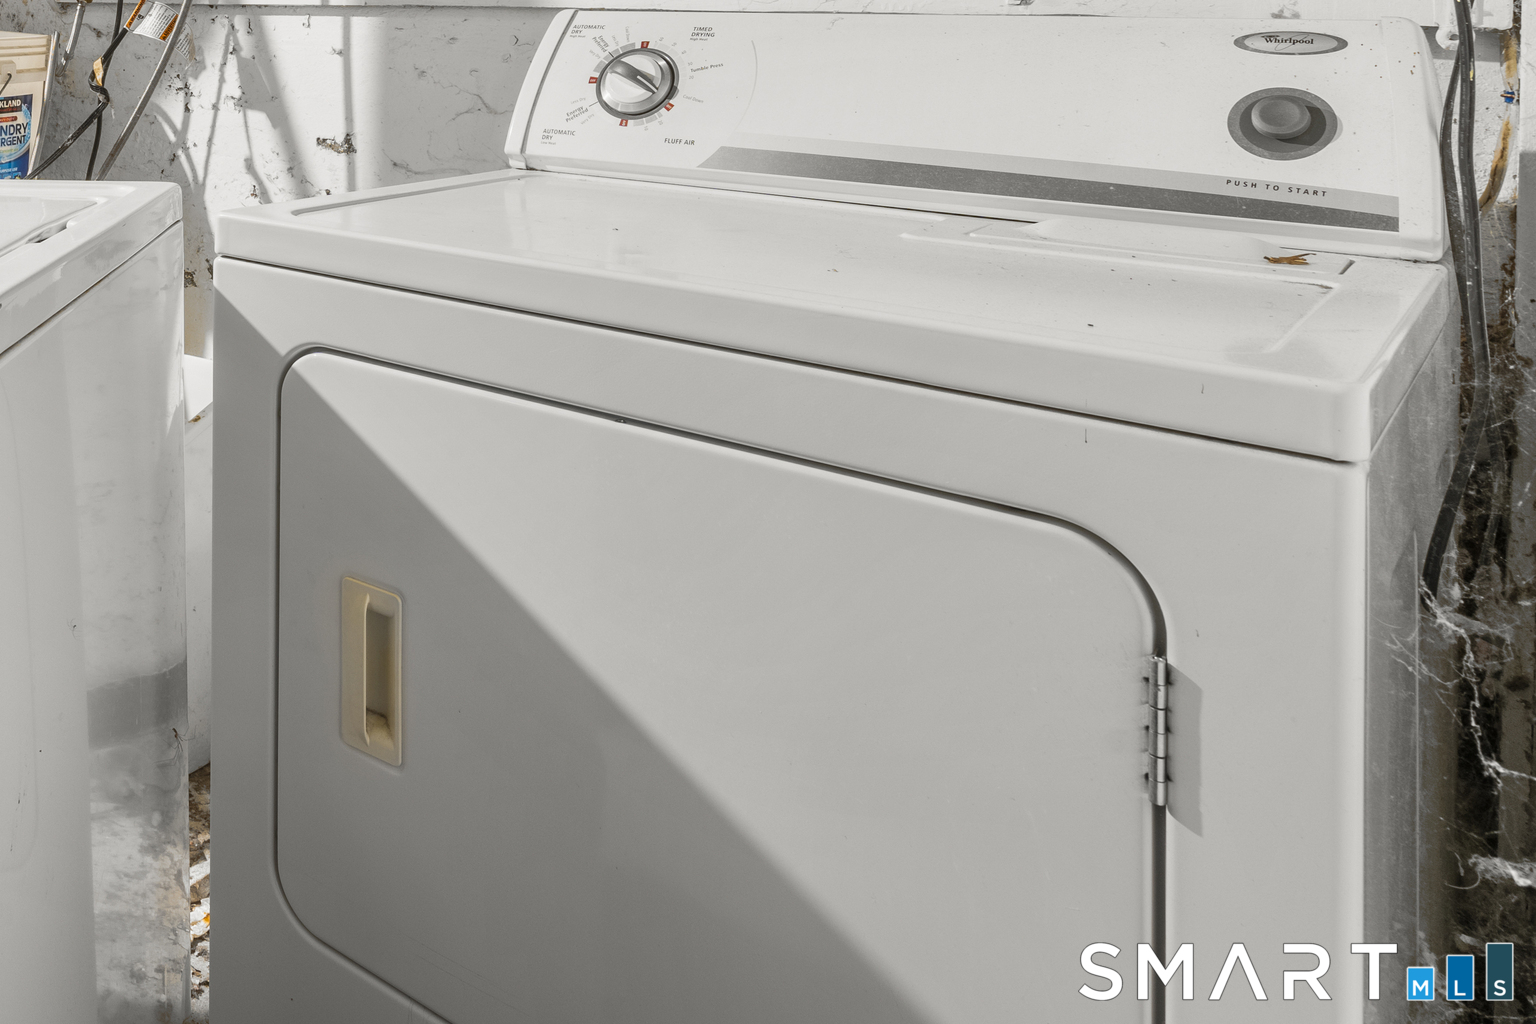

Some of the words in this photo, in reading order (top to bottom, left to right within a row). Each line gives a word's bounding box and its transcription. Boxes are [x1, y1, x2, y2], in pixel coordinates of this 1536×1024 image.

[1264, 36, 1315, 46] Whirlpool
[566, 106, 584, 117] Energy
[1226, 179, 1258, 189] PUSH
[1265, 183, 1281, 192] TO
[1288, 186, 1328, 198] START
